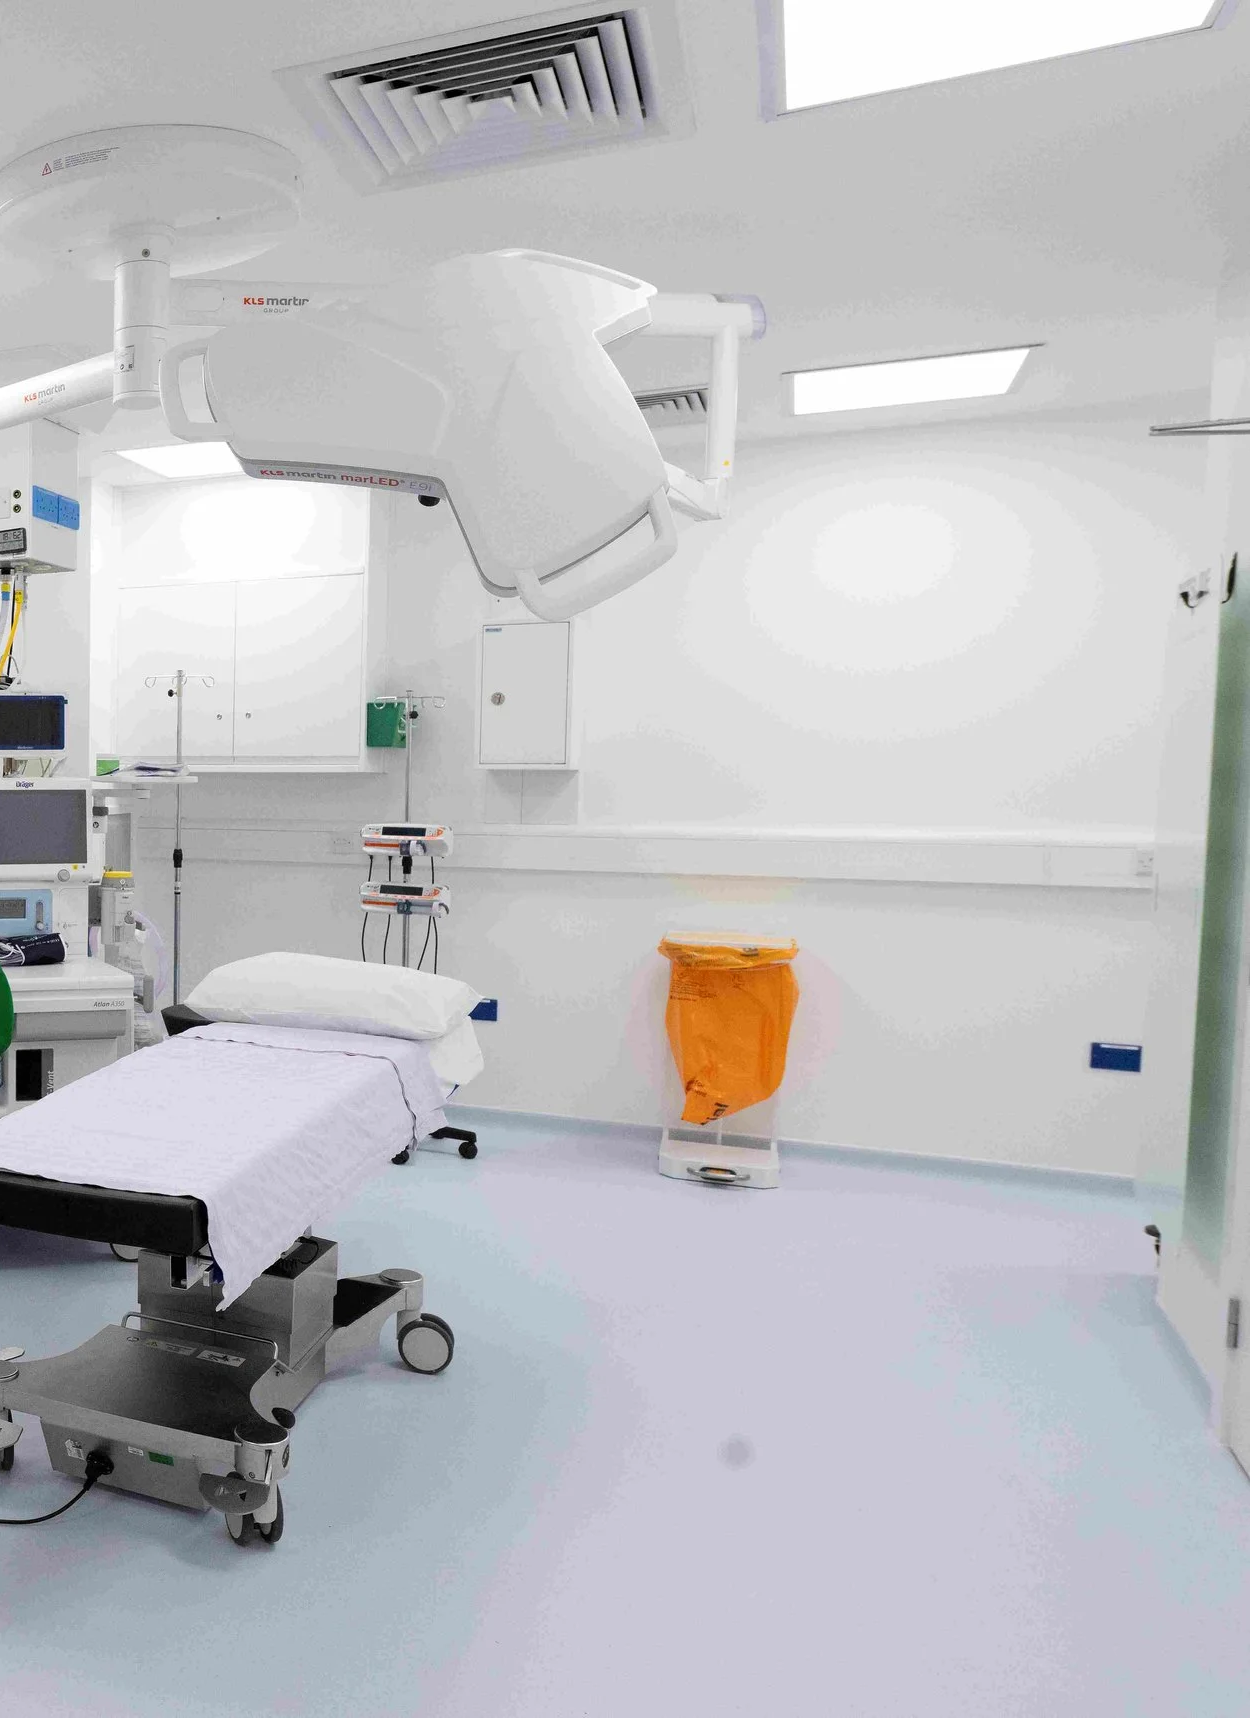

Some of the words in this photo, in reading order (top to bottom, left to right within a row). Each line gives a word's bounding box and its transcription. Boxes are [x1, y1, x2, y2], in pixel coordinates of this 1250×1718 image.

[243, 297, 265, 305] KLS
[24, 392, 37, 403] KLS
[37, 383, 65, 398] martin
[286, 470, 337, 480] martin
